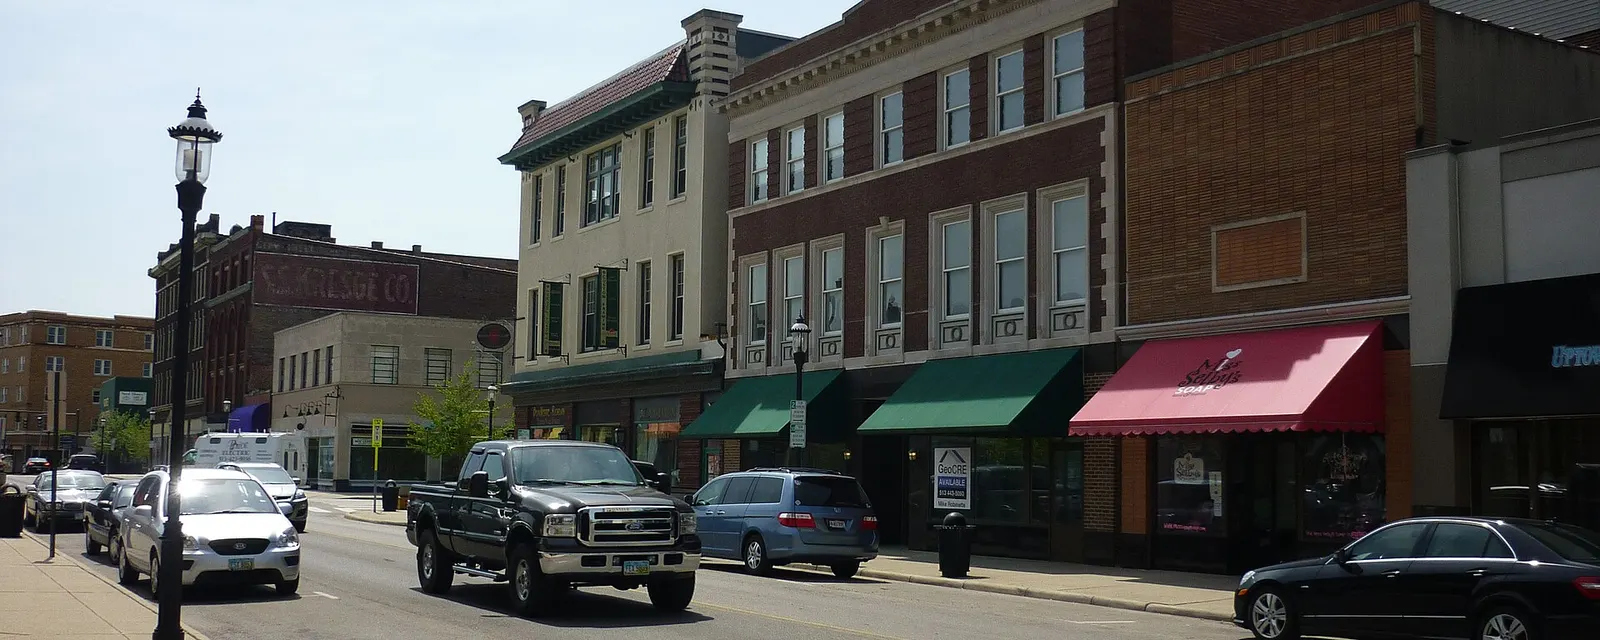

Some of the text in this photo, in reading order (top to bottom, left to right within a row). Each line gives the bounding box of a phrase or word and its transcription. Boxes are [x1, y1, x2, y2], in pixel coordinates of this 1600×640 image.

[1174, 385, 1214, 395] SOAP
[938, 463, 967, 475] GeoCRE
[939, 478, 966, 487] AVAILABLE
